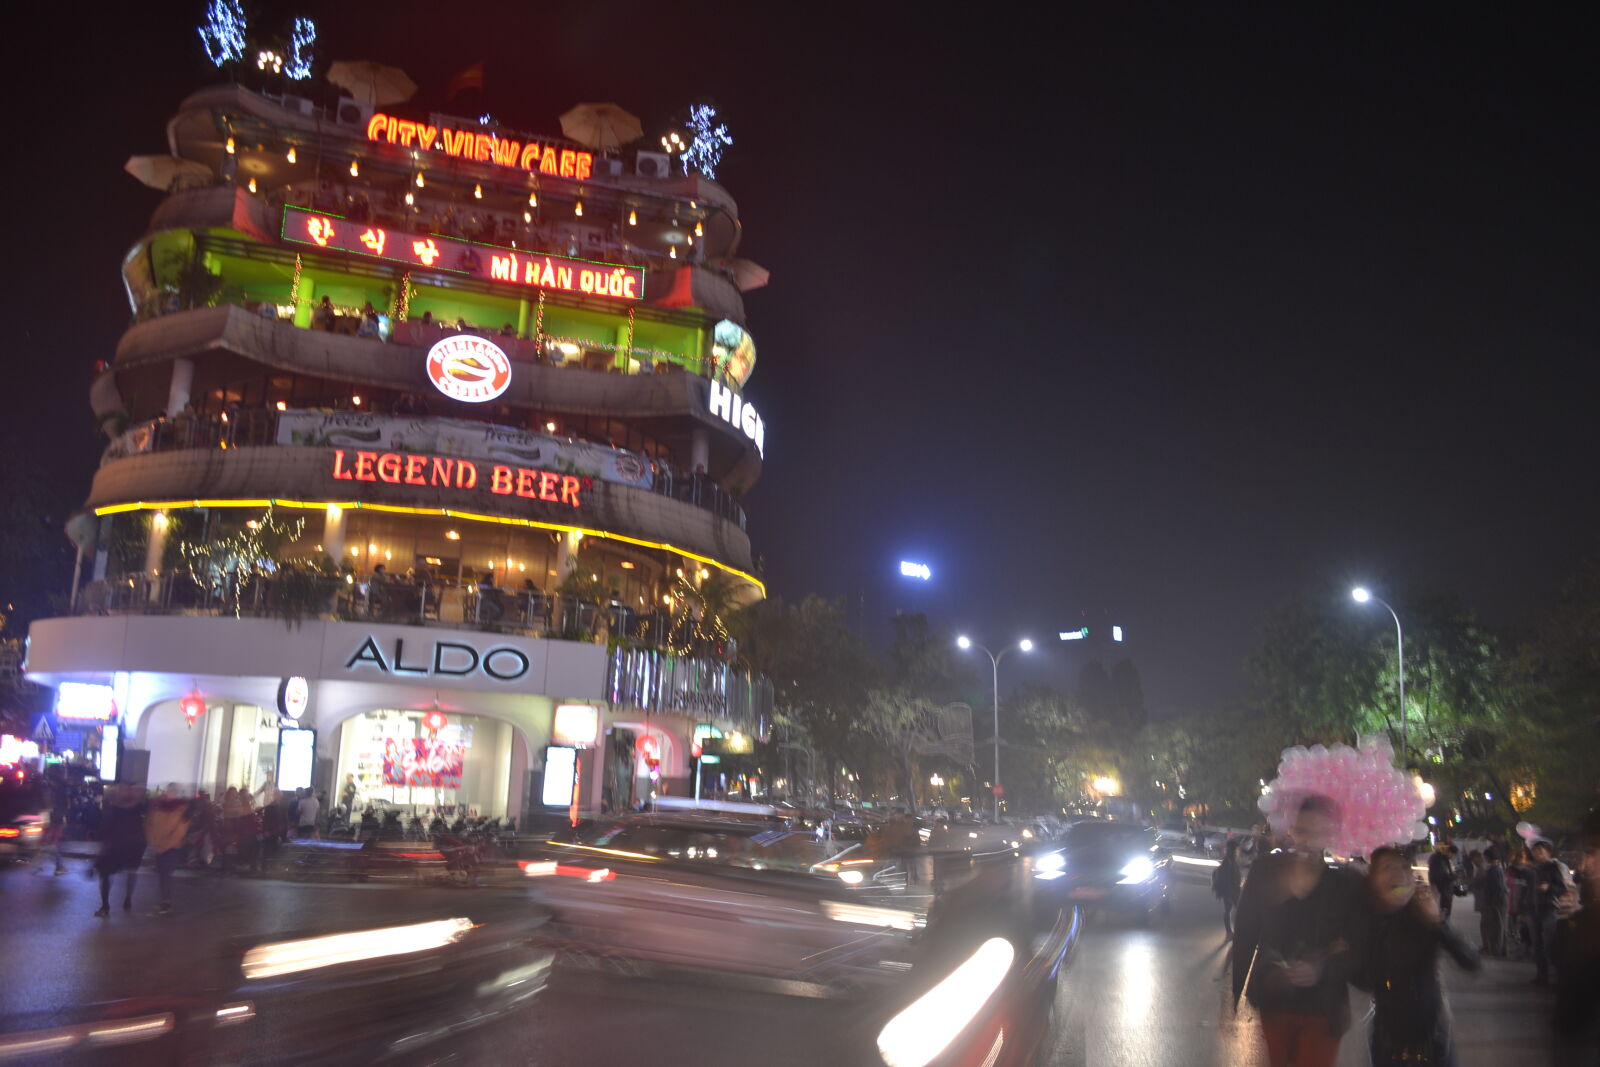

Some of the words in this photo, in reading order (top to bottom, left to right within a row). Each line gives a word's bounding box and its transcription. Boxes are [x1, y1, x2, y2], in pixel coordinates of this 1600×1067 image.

[367, 113, 437, 151] CITY
[443, 127, 520, 168] VIEW
[520, 142, 593, 181] CAFE
[490, 252, 518, 282] MÌ
[524, 257, 573, 290] HÀN
[332, 449, 478, 490] LEGEND
[491, 464, 581, 508] BEER
[344, 635, 530, 682] ALDO
